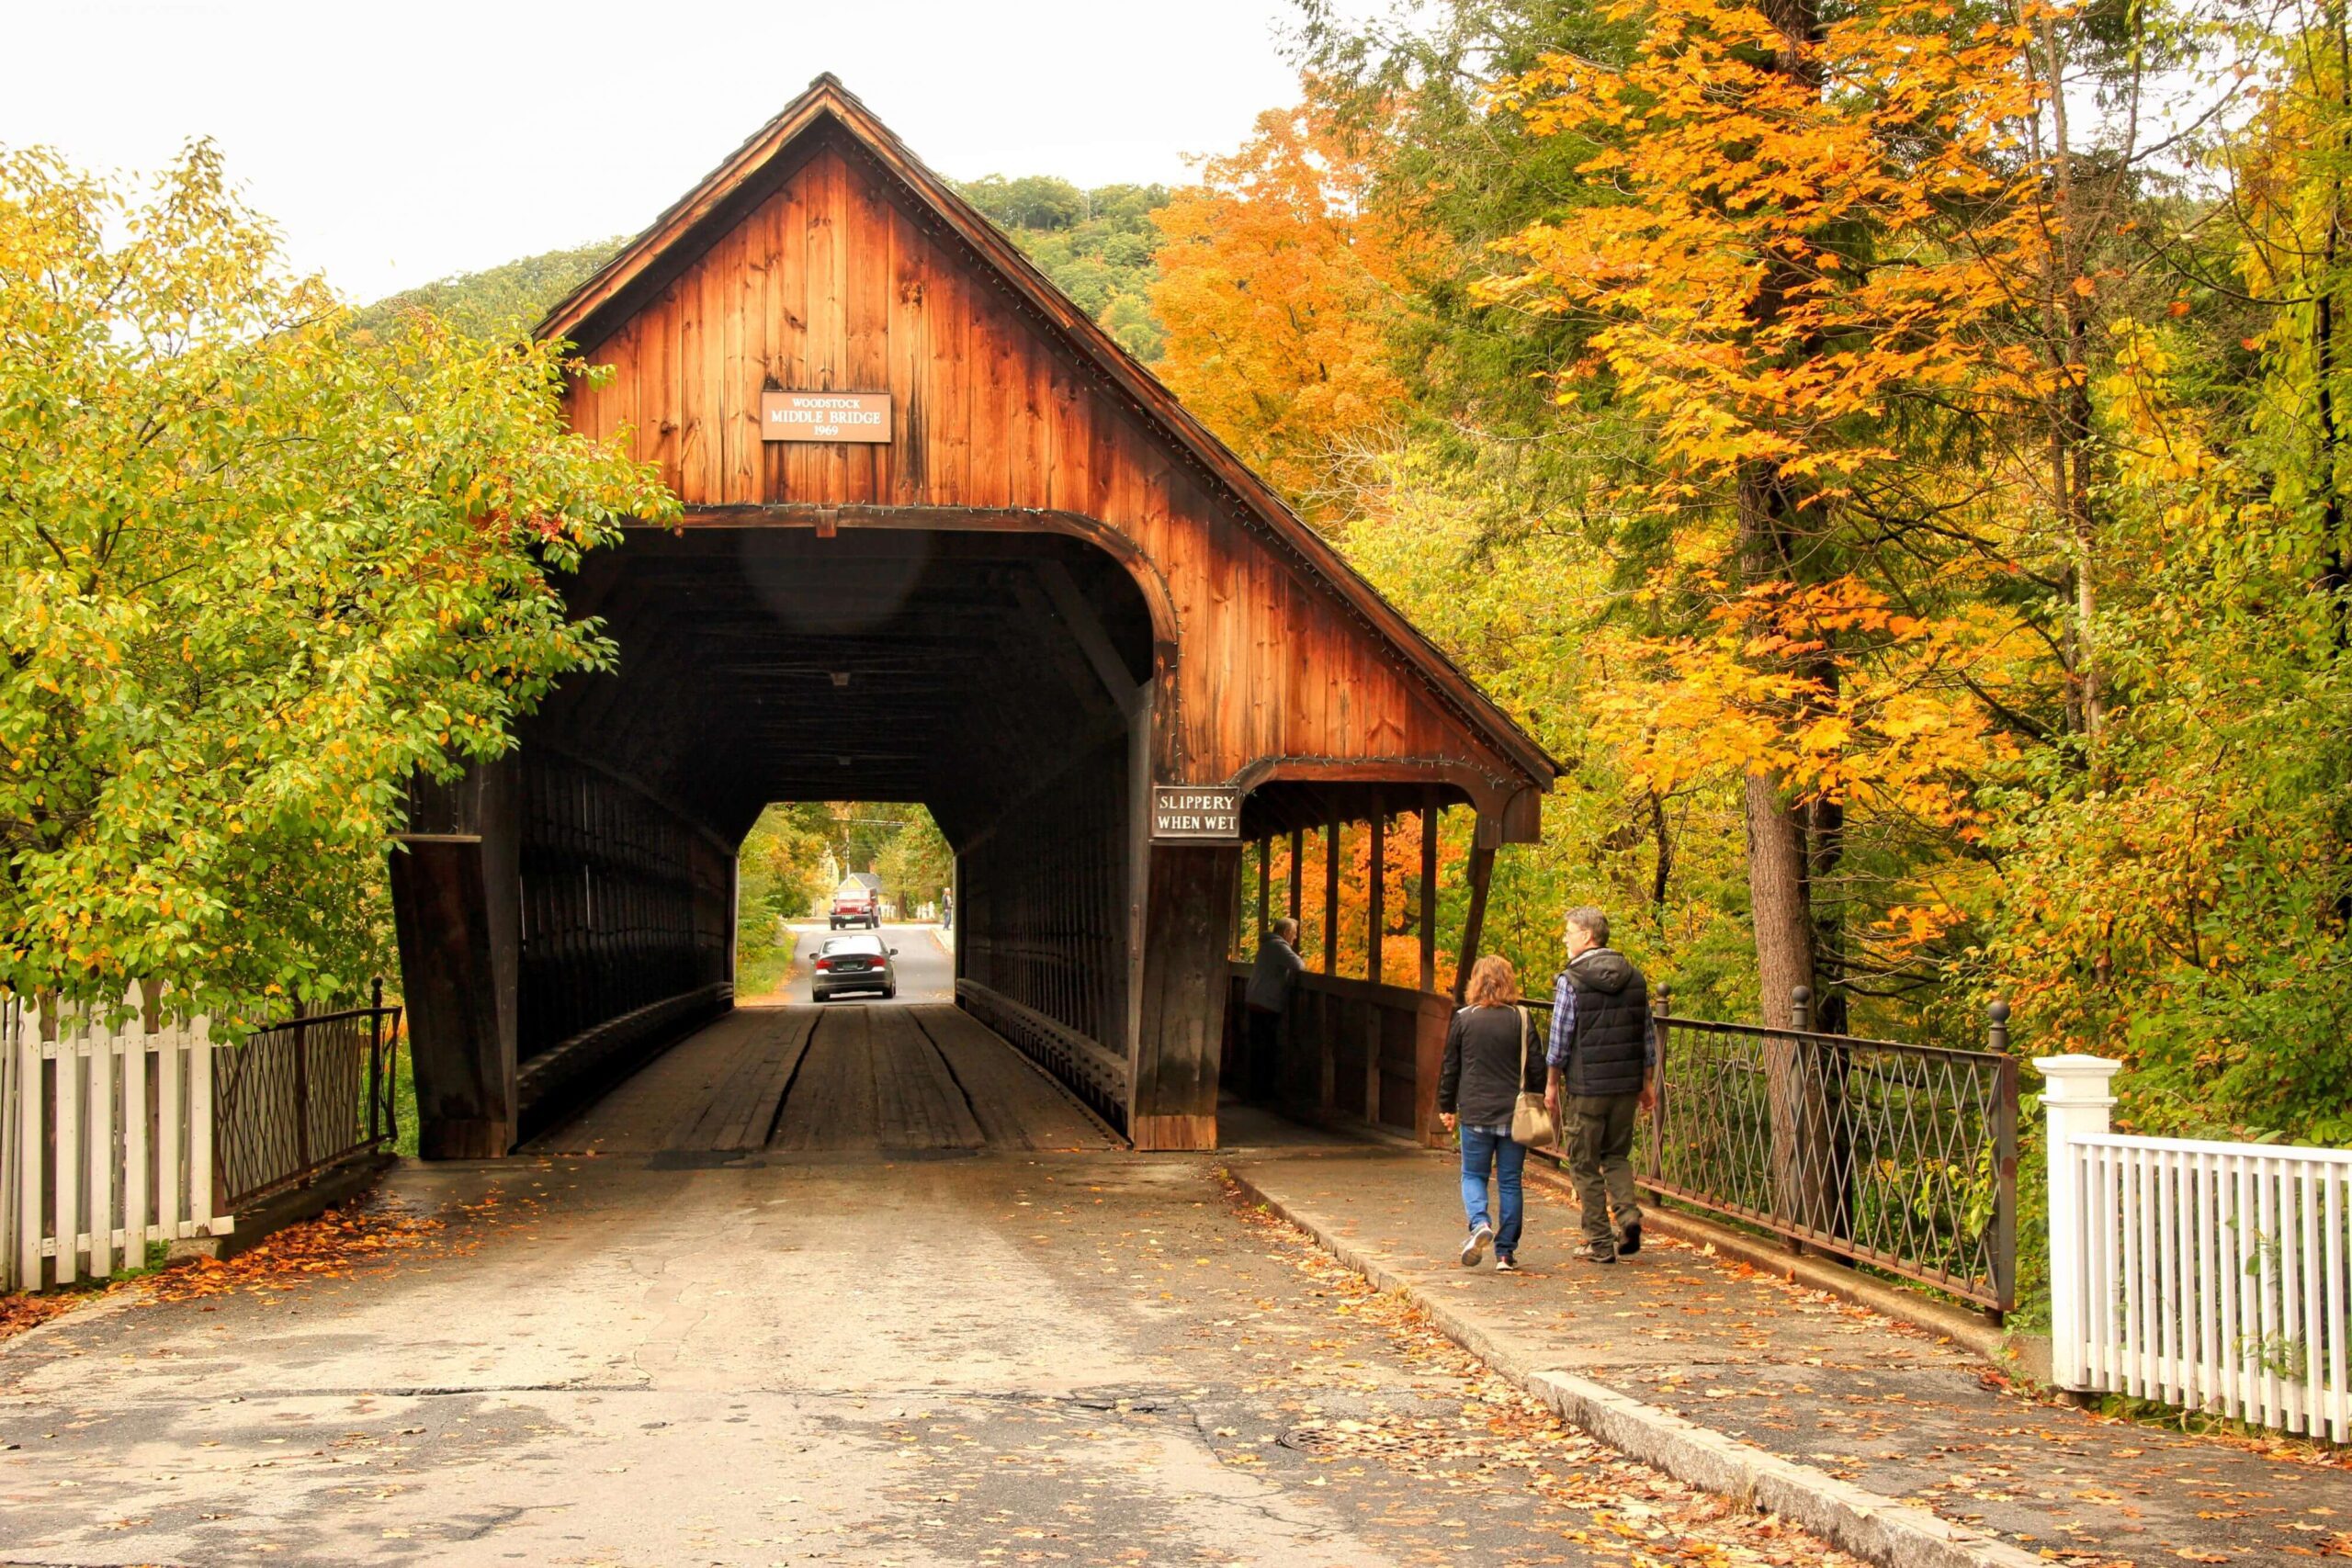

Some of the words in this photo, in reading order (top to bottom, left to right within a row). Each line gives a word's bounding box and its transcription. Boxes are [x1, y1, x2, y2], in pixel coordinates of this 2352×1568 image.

[792, 398, 860, 409] WOODSTOCK
[772, 410, 823, 423] MIDDLE
[830, 411, 881, 424] BRIDGE
[814, 425, 839, 435] 1969
[1159, 795, 1235, 809] SLIPPERY
[1158, 816, 1200, 829] WHEN
[1204, 816, 1237, 830] WET
